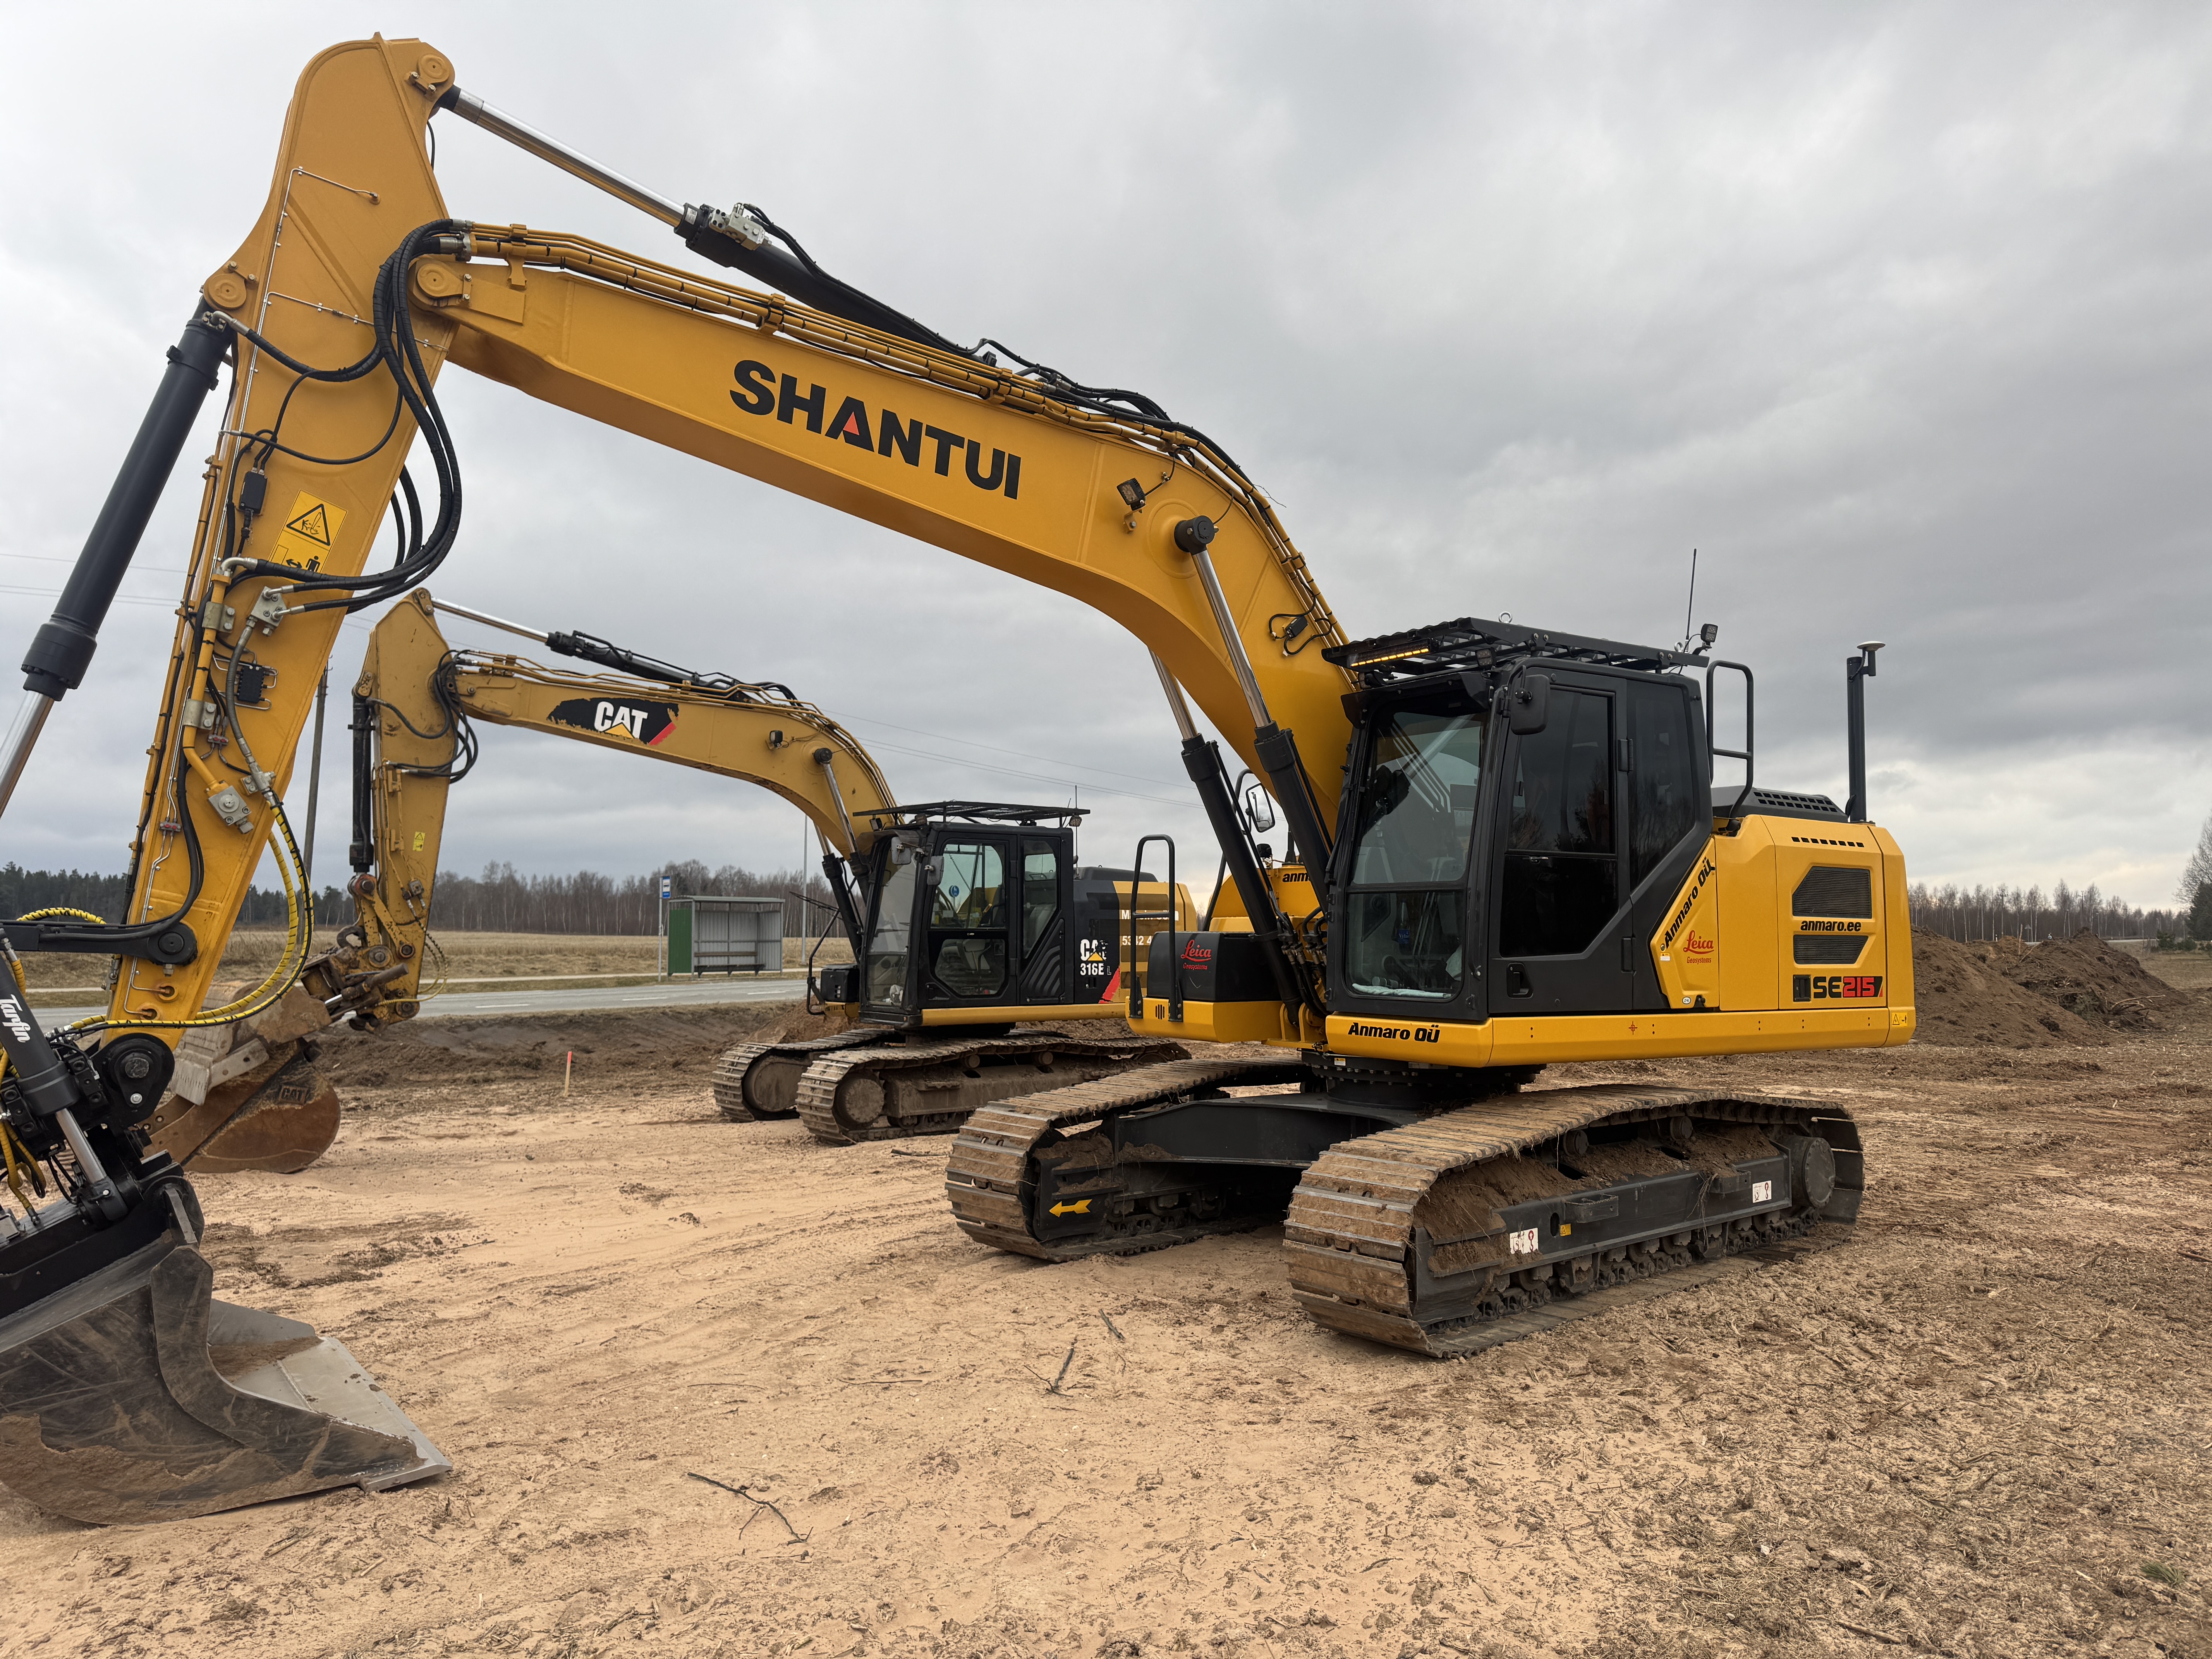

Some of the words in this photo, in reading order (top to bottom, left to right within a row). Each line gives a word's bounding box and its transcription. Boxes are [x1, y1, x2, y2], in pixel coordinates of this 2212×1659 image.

[730, 360, 1022, 500] SHANTUI
[594, 701, 648, 738] CAT
[1282, 872, 1310, 882] anm
[1665, 886, 1698, 949] Anmaro
[1800, 920, 1862, 932] anmaro.ee
[1122, 936, 1144, 946] 532
[1180, 939, 1211, 962] Leica
[1683, 930, 1714, 955] Leica
[1080, 963, 1104, 975] 316E
[1183, 962, 1207, 970] Geosystems
[1687, 957, 1712, 965] Geosystems
[1813, 976, 1875, 998] SE215
[1348, 1022, 1411, 1040] Anmaro
[1414, 1024, 1440, 1043] OÜ
